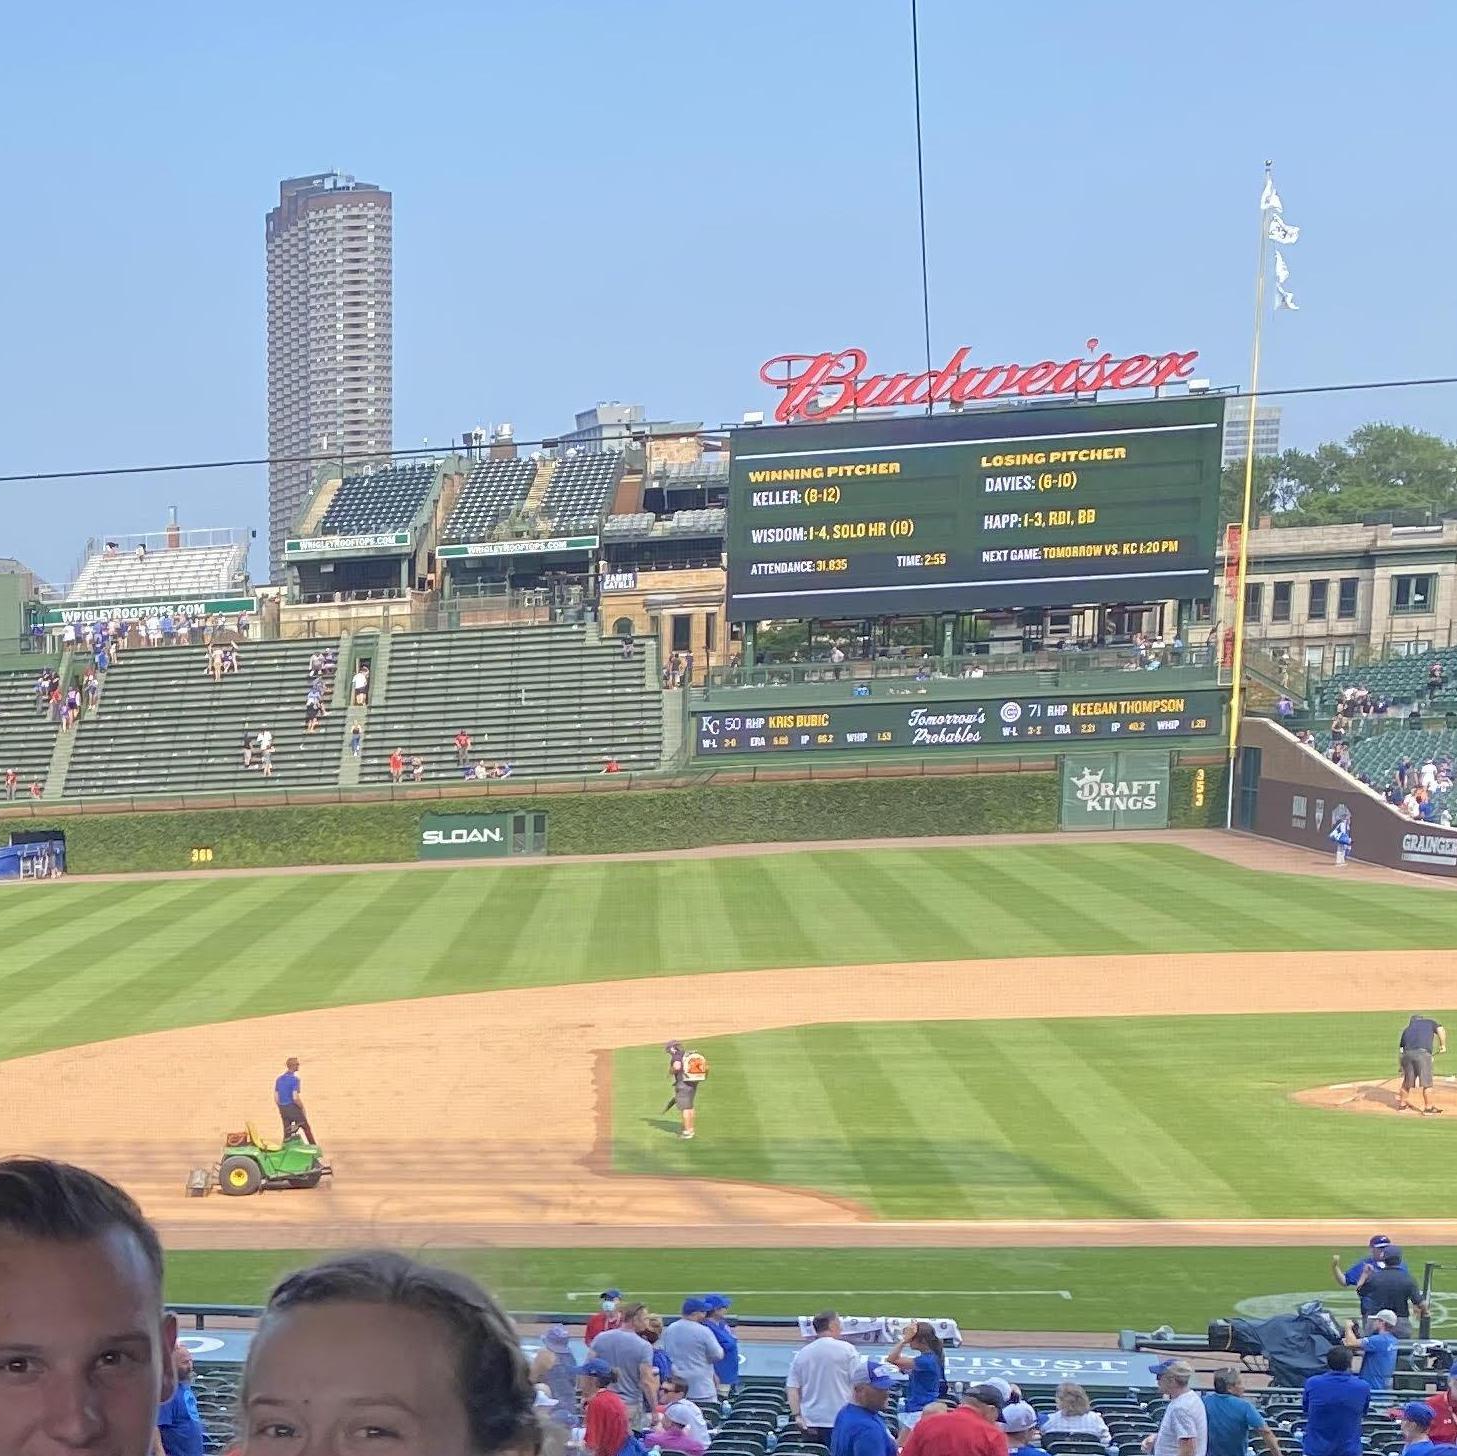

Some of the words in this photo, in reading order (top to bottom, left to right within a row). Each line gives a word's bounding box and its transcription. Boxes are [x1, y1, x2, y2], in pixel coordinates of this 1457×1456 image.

[760, 338, 1199, 422] Budweiser
[981, 452, 1046, 467] LOSING
[1049, 447, 1127, 463] PITCHER
[749, 467, 825, 483] WINNING
[827, 462, 901, 477] PITCHER
[985, 475, 1036, 493] DAVIES:
[1038, 471, 1078, 491] (6-10)
[752, 490, 802, 506] KELLER:
[804, 486, 841, 506] (8-12)
[984, 513, 1021, 530] HAPP:
[1023, 512, 1046, 528] 1-3,
[1077, 509, 1096, 524] BB
[751, 527, 808, 544] WISDOM:
[833, 523, 865, 539] SOLO
[868, 522, 886, 537] HR
[896, 554, 923, 567] TIME:
[982, 550, 1008, 563] NEXT
[1010, 548, 1042, 561] GAME:
[1043, 545, 1103, 559] TOMORROW
[1104, 543, 1121, 556] VS.
[1123, 542, 1138, 554] KC
[1161, 540, 1179, 552] PM
[751, 561, 816, 576] ATTENDANCE:
[62, 604, 206, 623] WRIGLEYROOFTOPS.COM
[909, 707, 986, 728] Tomorrow's
[1028, 704, 1041, 717] 71
[1072, 701, 1118, 717] KEEGAN
[1120, 698, 1185, 715] THOMPSON
[724, 717, 742, 731] 50
[768, 714, 794, 729] KRIS
[796, 713, 830, 728] BUBIC
[912, 726, 981, 745] Probables
[1076, 781, 1160, 800] DRAFT
[1087, 796, 1157, 812] KINGS
